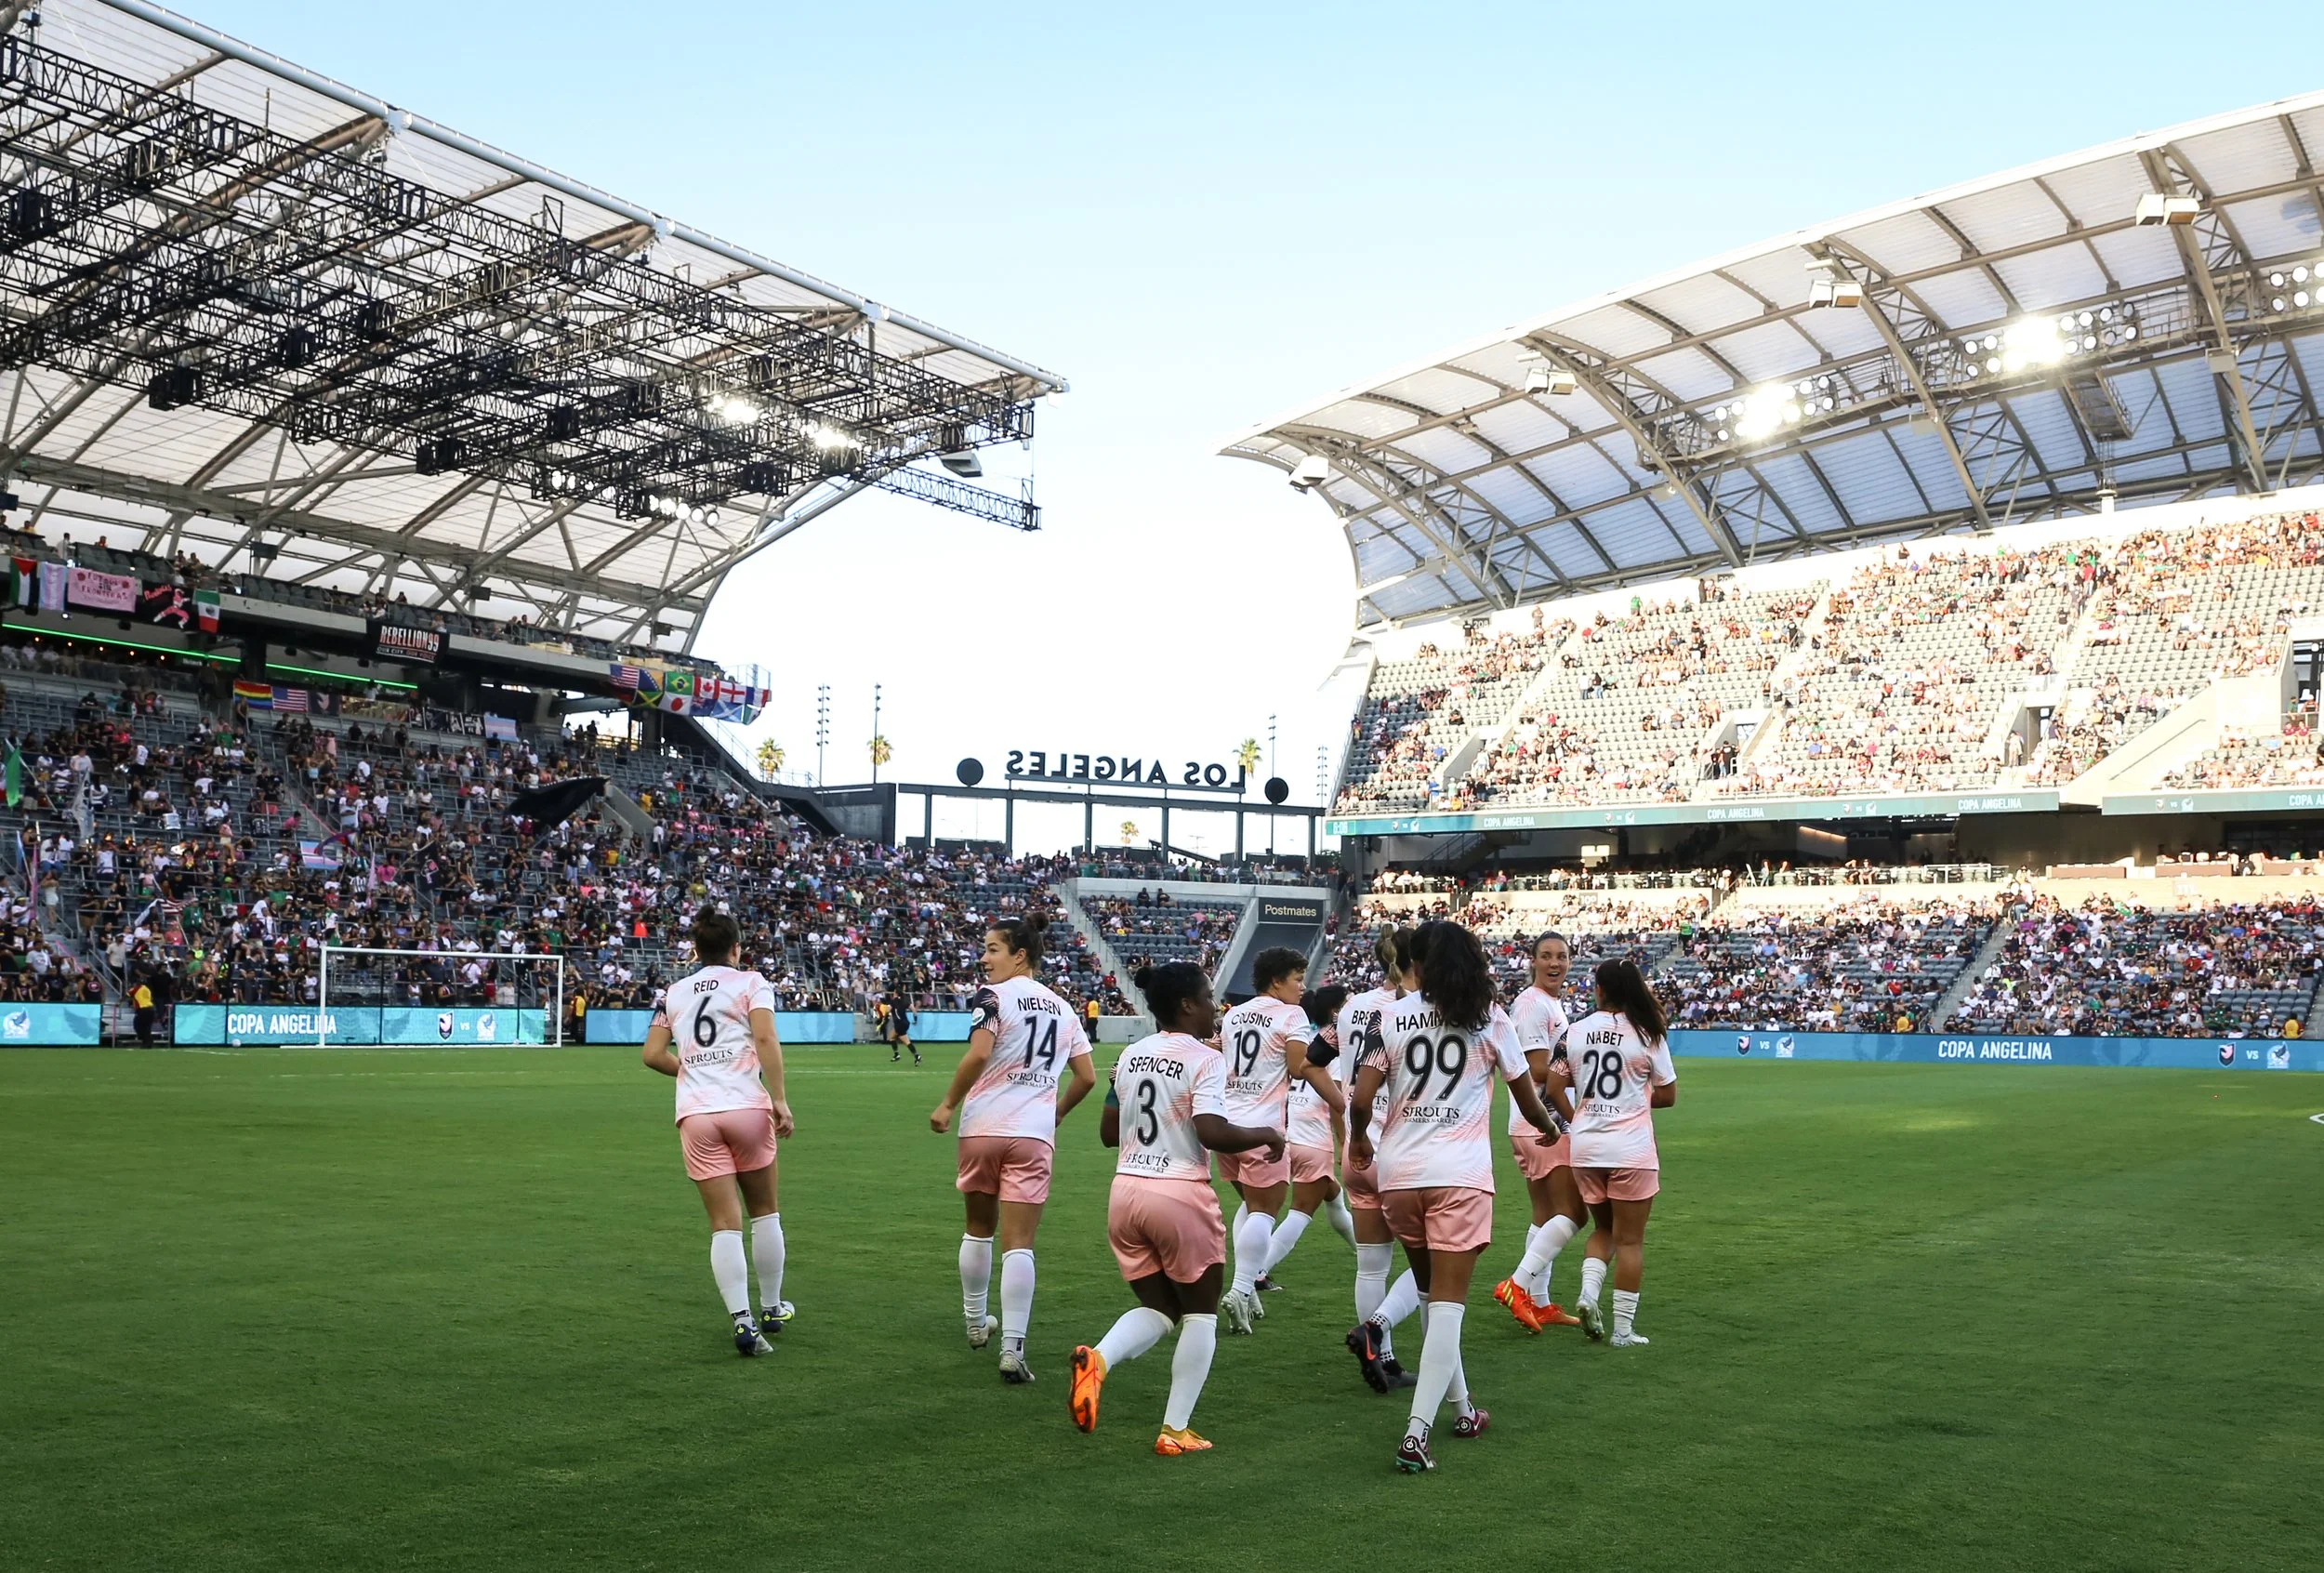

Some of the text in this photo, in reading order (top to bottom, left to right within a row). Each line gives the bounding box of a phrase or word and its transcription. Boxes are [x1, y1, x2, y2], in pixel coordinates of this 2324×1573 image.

[379, 625, 440, 653] REBELLION99
[1958, 797, 2022, 811] COPA ANGELINA
[2289, 795, 2313, 807] COPA
[1484, 816, 1535, 827] COPA ANGELINA
[1707, 807, 1764, 820] COPA ANGELINA
[1264, 904, 1316, 917] Postmates
[693, 980, 720, 995] REID
[1017, 998, 1062, 1016] NIELSEN
[227, 1013, 265, 1034] COPA
[693, 995, 717, 1048] 6
[1231, 1011, 1273, 1028] COUSINS
[1024, 1014, 1058, 1073] 14
[1586, 1031, 1624, 1047] NABET
[684, 1049, 733, 1065] SPROUTS
[1233, 1030, 1261, 1077] 19
[1938, 1041, 2053, 1060] COPA ANGELINA
[2246, 1050, 2259, 1060] VS
[1129, 1056, 1184, 1080] SPENCER
[1406, 1034, 1467, 1101] 99
[1582, 1050, 1623, 1101] 28
[1006, 1073, 1056, 1084] SPROUTS
[1227, 1080, 1262, 1091] SPROUTS
[1138, 1078, 1158, 1146] 3
[1402, 1106, 1459, 1119] SPROUTS
[1125, 1153, 1169, 1168] PROUTS
